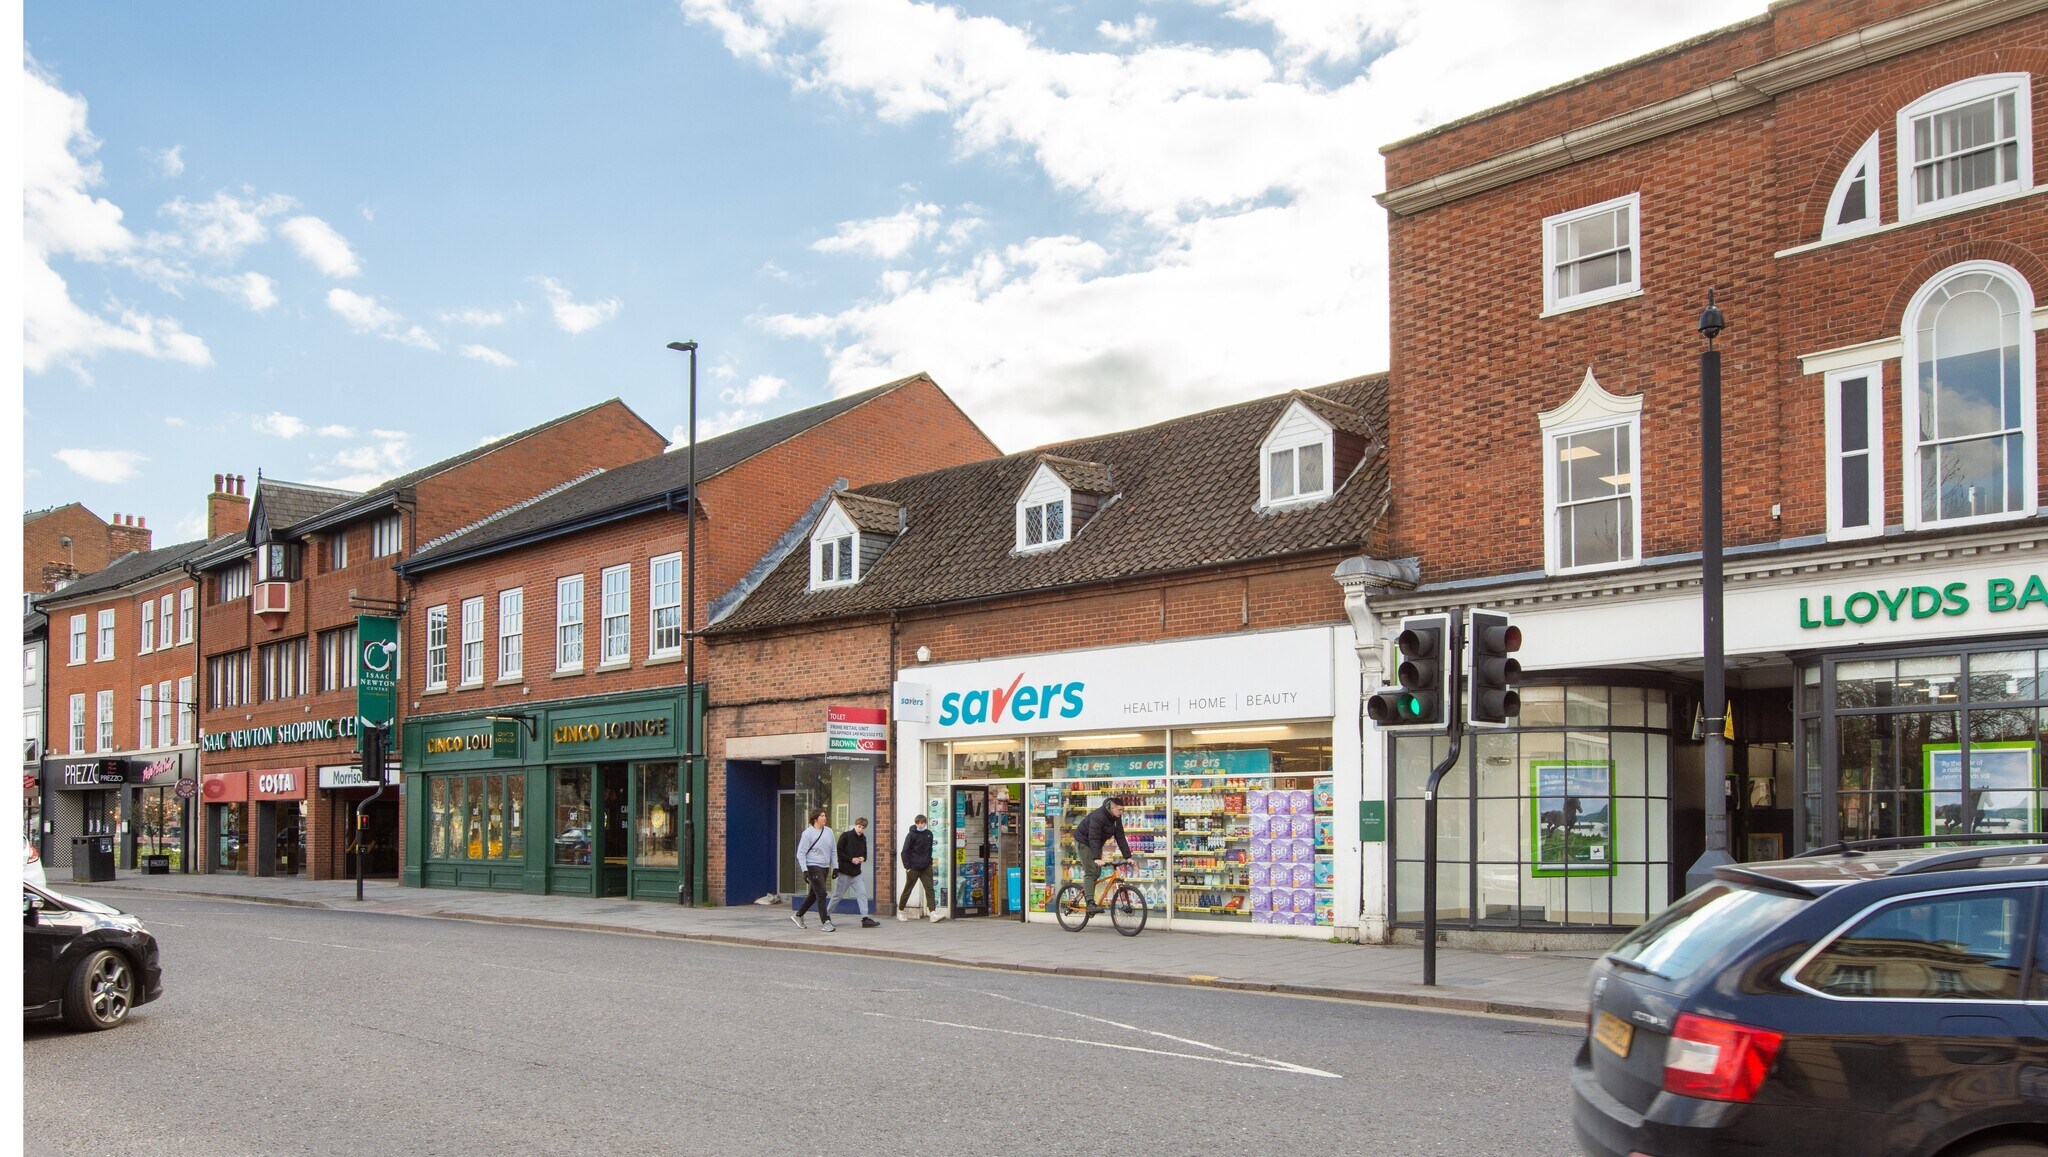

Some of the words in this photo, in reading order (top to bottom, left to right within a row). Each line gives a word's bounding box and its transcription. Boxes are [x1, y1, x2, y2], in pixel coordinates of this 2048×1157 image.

[1800, 582, 1970, 629] LLOYDS
[1988, 575, 2048, 613] BA
[360, 678, 395, 686] NEWTON
[900, 697, 924, 706] savers
[938, 672, 1085, 727] savers
[1123, 701, 1169, 714] HEALTH
[1188, 697, 1226, 710] HOME
[1246, 692, 1298, 706] BEAUTY
[554, 724, 600, 743] CINCO
[604, 717, 666, 739] LOUNGE
[202, 732, 226, 752] ISAAC
[230, 726, 273, 748] NEWTON
[278, 718, 332, 743] SHOPPING
[427, 736, 463, 753] CINCO
[964, 751, 1021, 770] 40-41
[1129, 760, 1164, 770] savers
[1184, 758, 1220, 769] savers
[1076, 761, 1110, 772] savers
[259, 774, 292, 794] COSTA
[1290, 799, 1308, 807] Soft
[1249, 823, 1265, 831] Soft
[1292, 847, 1309, 855] Soft
[1249, 871, 1265, 879] Soft
[1271, 871, 1287, 879] Soft
[1293, 873, 1311, 881] Soft
[1250, 895, 1265, 903] Soft
[1273, 897, 1290, 905] Soft
[1294, 897, 1310, 905] Soft
